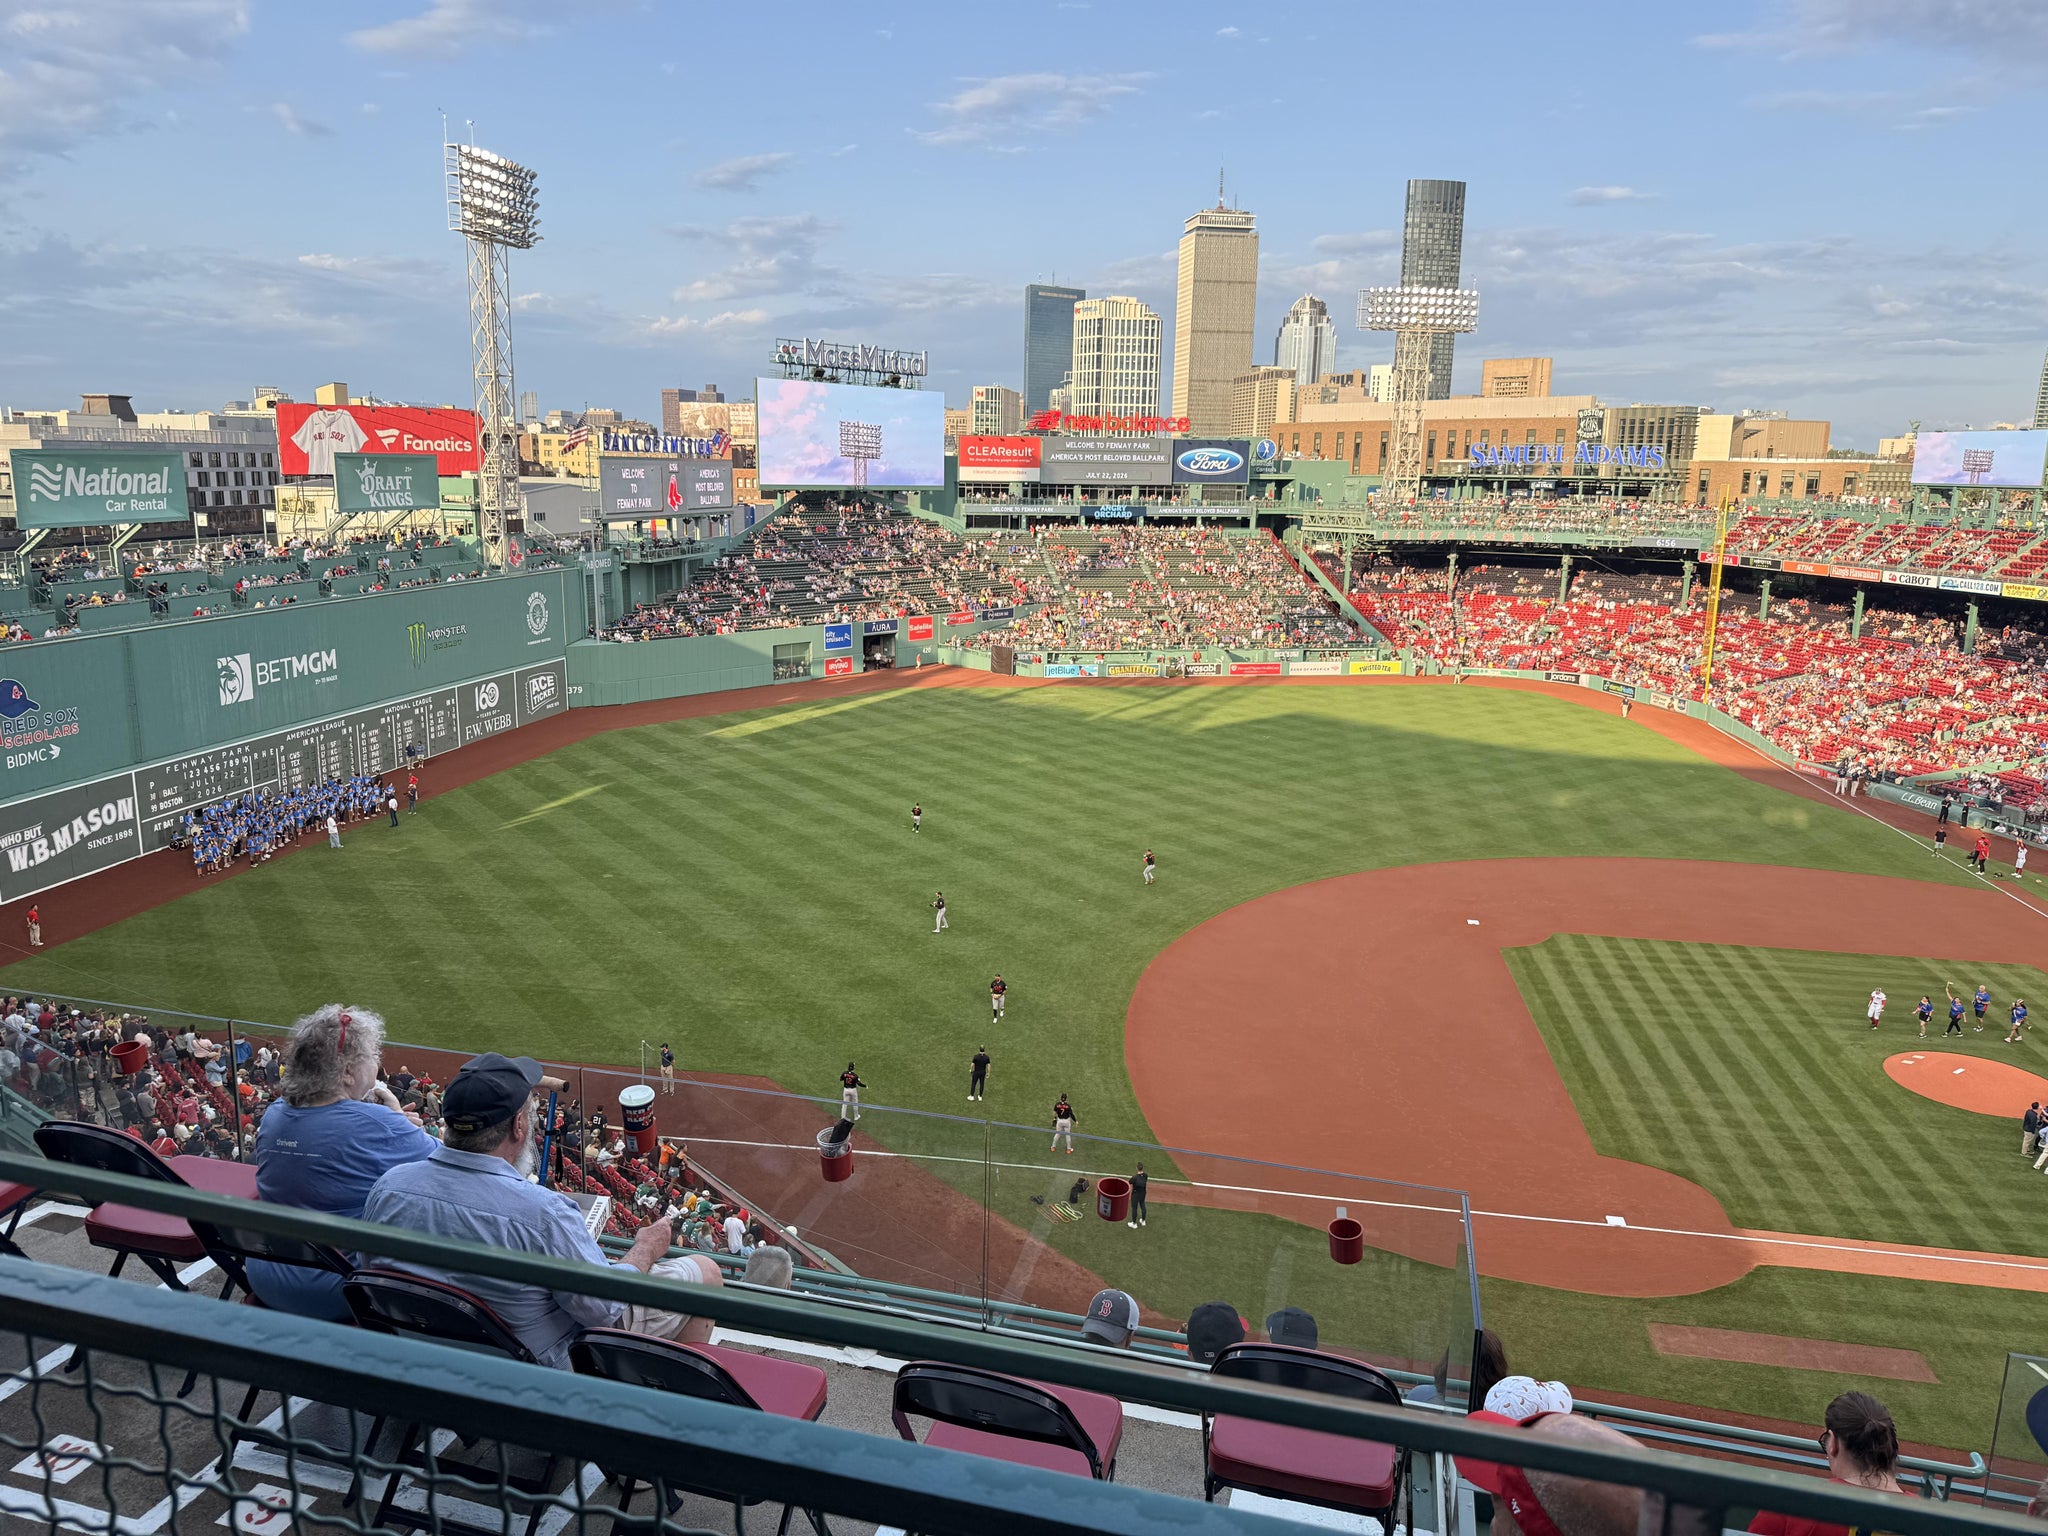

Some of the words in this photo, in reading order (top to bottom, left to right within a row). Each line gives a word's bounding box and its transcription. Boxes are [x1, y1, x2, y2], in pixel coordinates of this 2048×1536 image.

[803, 337, 928, 377] MassMutual
[1106, 411, 1191, 433] balance
[330, 430, 346, 443] SOX
[602, 433, 640, 452] BANK
[403, 434, 473, 452] Fanatics
[1065, 441, 1095, 449] WELCOME
[1096, 441, 1104, 449] TO
[1105, 441, 1132, 449] FENWAY
[1133, 441, 1151, 450] PARK
[967, 445, 1032, 457] CLEAResult
[1469, 441, 1570, 469] SAMUEL
[1574, 440, 1665, 470] ADAMS
[1050, 453, 1083, 461] AMERICA'S
[1084, 453, 1102, 461] MOST
[1132, 454, 1165, 462] BALLPARK
[1189, 452, 1231, 470] Ford
[621, 468, 645, 479] WELCOME
[699, 469, 720, 479] AMERICA'S
[360, 473, 412, 495] DRAFT
[630, 483, 638, 494] TO
[695, 482, 706, 492] MOST
[707, 482, 725, 492] BELOVED
[105, 499, 127, 512] Car
[130, 497, 167, 511] Rental
[368, 491, 414, 507] KINGS
[616, 498, 639, 509] FENWAY
[639, 497, 652, 509] PARK
[700, 495, 721, 505] BALLPARK
[1094, 510, 1133, 518] ORCHARD
[1656, 539, 1676, 547] 6:56
[1796, 564, 1815, 572] STIHL
[825, 631, 836, 639] city
[826, 635, 844, 643] cruises
[255, 648, 337, 686] BETMGM
[828, 661, 849, 670] IRVING
[1047, 665, 1076, 676] jetBlue
[1108, 665, 1141, 675] GRANITE
[1141, 664, 1159, 675] CITY
[1186, 663, 1217, 672] wasabi
[1359, 664, 1381, 673] TWISTED
[531, 675, 555, 696] ACE
[568, 686, 583, 695] 379
[532, 686, 556, 705] TICKET
[384, 703, 411, 714] NATIONAL
[412, 696, 433, 706] LEAGUE
[3, 716, 39, 735] RED
[43, 706, 79, 725] SOX
[484, 713, 512, 733] WEBB
[4, 722, 80, 749] SCHOLARS
[286, 726, 320, 741] AMERICAN
[321, 720, 346, 731] LEAGUE
[330, 740, 337, 749] SF
[289, 751, 301, 760] CWS
[330, 748, 338, 756] KC
[6, 748, 48, 770] BIDMC
[165, 754, 213, 774] FENWAY
[221, 745, 251, 759] PARK
[290, 759, 300, 768] TEX
[291, 774, 303, 784] TOR
[149, 781, 155, 790] P
[162, 785, 178, 798] BALT
[159, 795, 183, 811] BOSTON
[243, 776, 249, 784] 6
[153, 823, 162, 832] AT
[162, 818, 175, 829] BAT
[0, 832, 22, 849] WHO
[23, 825, 42, 841] BUT
[87, 834, 114, 850] SINCE
[114, 828, 134, 841] 1898
[592, 1115, 601, 1125] 21
[1098, 1299, 1113, 1317] B
